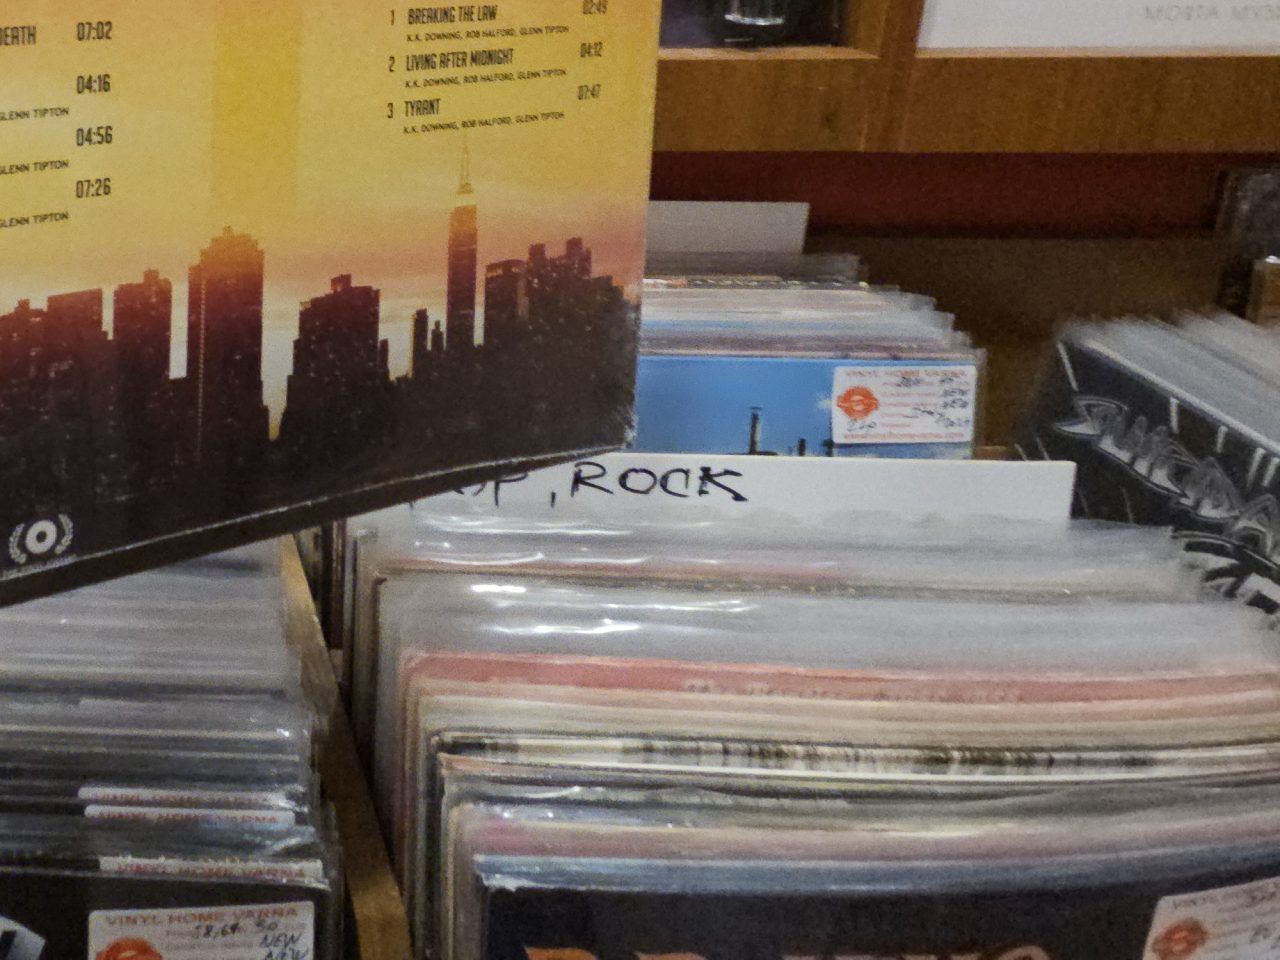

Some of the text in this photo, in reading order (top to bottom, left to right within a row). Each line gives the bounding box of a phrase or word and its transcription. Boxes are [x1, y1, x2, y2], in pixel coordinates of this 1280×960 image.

[390, 8, 396, 26] 1
[408, 6, 456, 25] BREAKING
[458, 5, 477, 23] THE
[477, 3, 498, 21] LAW
[76, 21, 113, 42] 07:02
[388, 56, 396, 73] 2
[406, 53, 438, 72] LIVING
[439, 51, 467, 69] AFTER
[469, 48, 514, 67] MIDNIGHT
[76, 74, 112, 95] 04:16
[386, 103, 394, 119] 3
[404, 98, 441, 117] TYRANT
[76, 125, 113, 147] 04:56
[75, 178, 112, 199] 07:26
[104, 906, 299, 926] VINYL HOME VARNA
